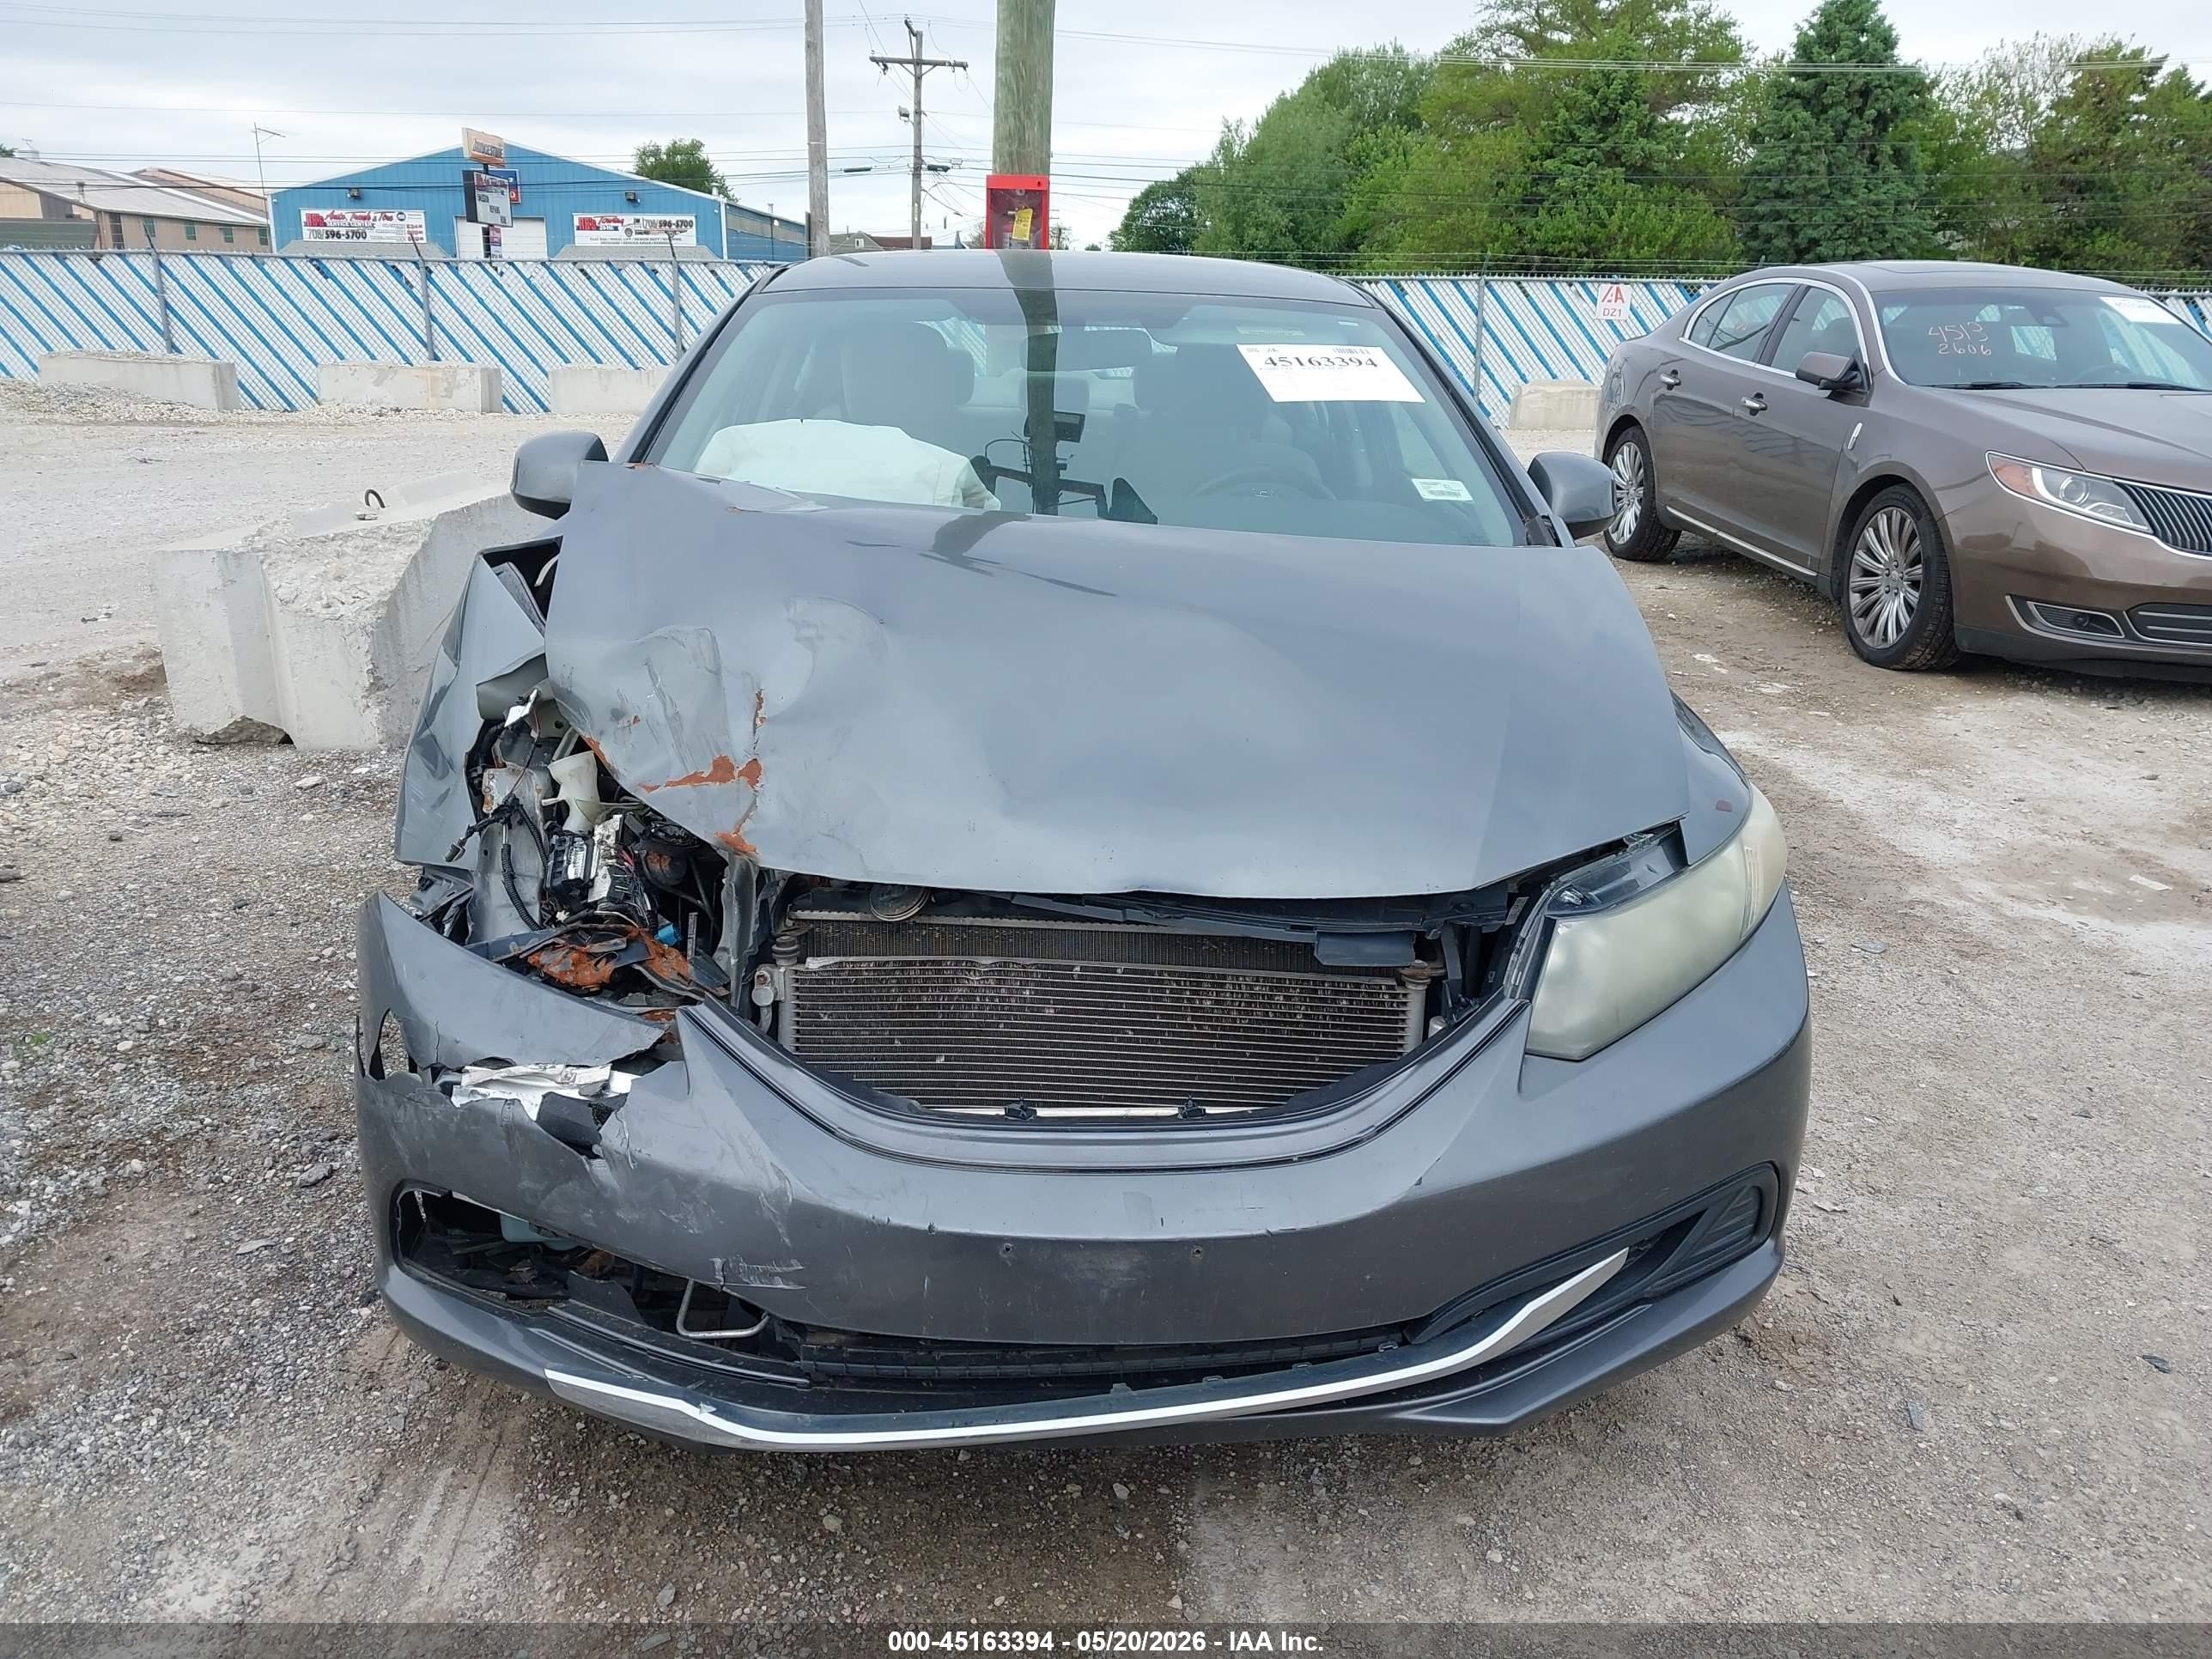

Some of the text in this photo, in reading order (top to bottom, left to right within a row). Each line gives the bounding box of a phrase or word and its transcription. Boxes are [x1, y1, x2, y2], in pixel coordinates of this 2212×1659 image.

[1602, 308, 1621, 317] DZ1
[1928, 321, 1990, 343] 4513
[1938, 343, 1992, 356] 2606
[1264, 356, 1378, 368] 45163394
